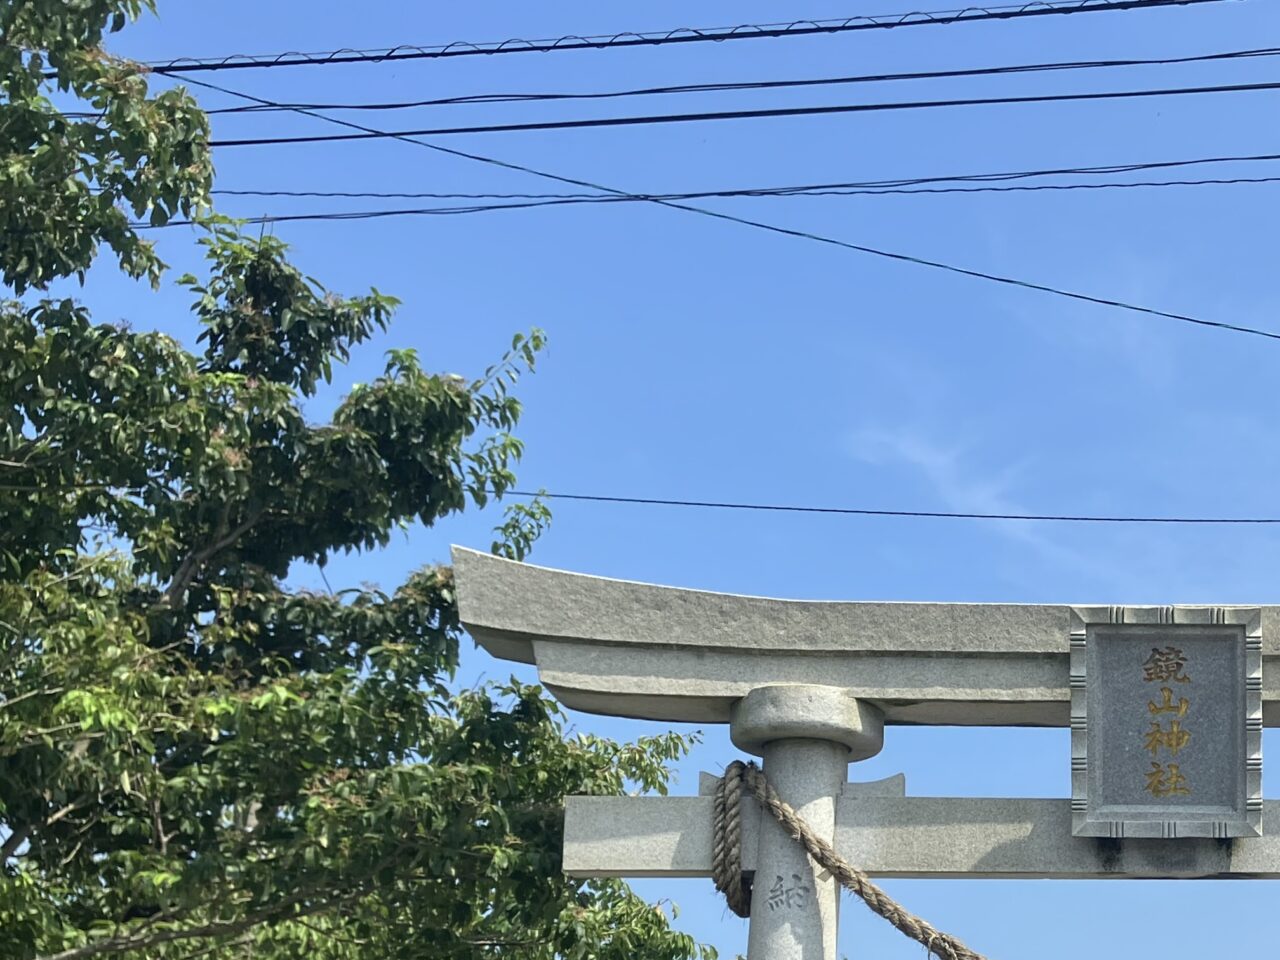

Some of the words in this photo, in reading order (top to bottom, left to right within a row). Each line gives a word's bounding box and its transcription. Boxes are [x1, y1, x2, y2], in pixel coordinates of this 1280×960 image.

[1142, 646, 1191, 798] 鏡山神社
[767, 873, 810, 911] 納
